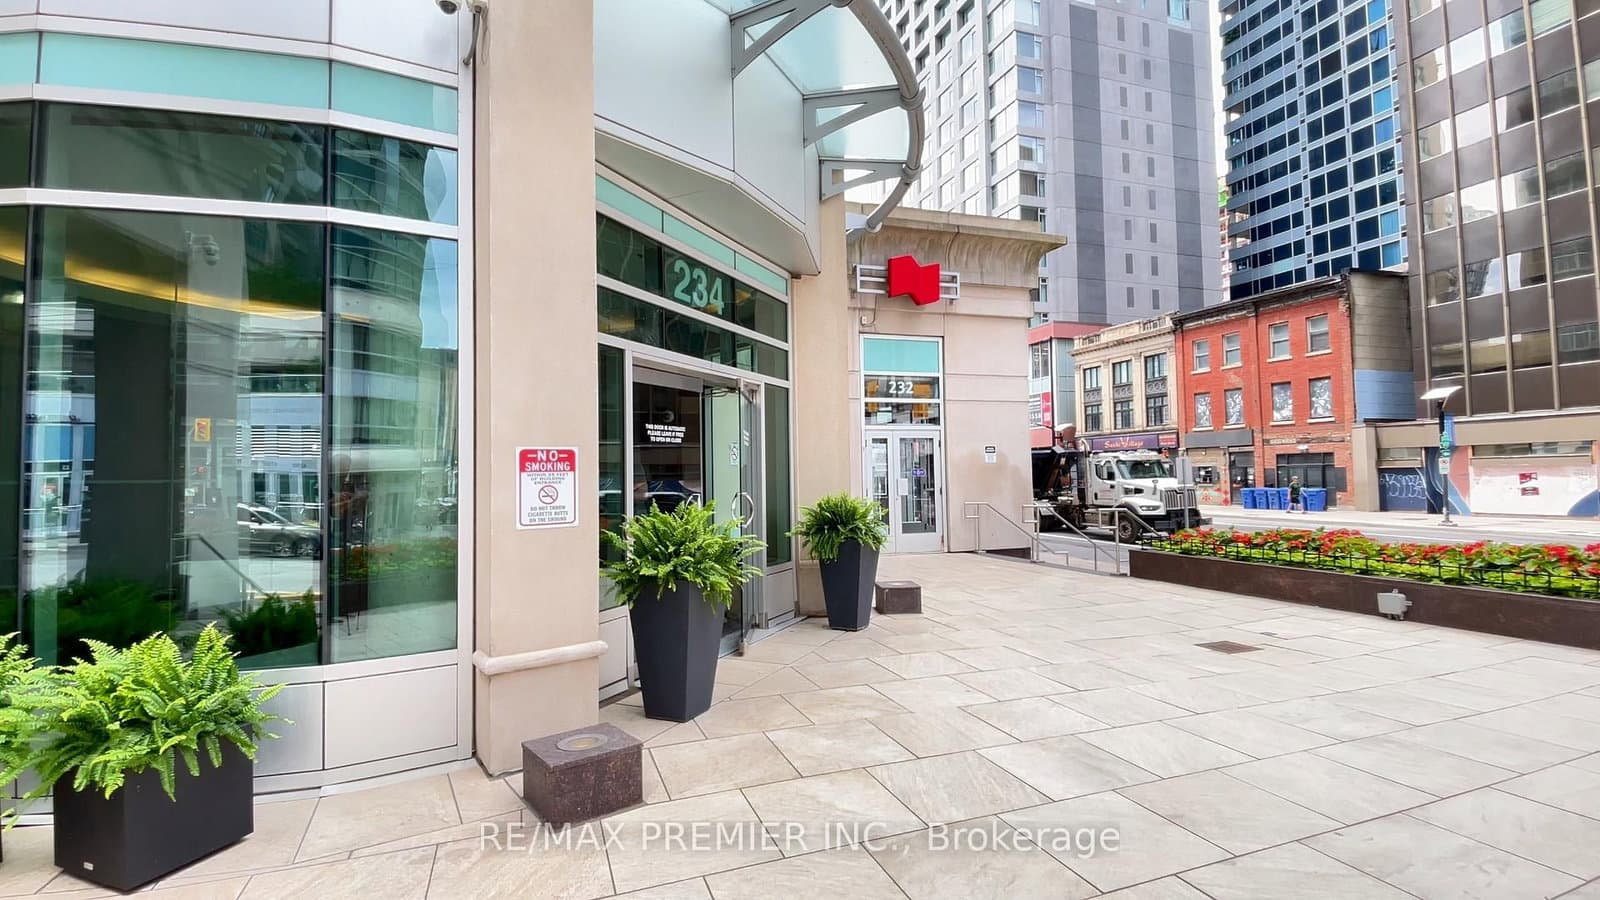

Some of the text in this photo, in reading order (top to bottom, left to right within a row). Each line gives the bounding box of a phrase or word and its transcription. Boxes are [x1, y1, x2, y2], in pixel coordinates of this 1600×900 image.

[674, 259, 725, 315] 234
[888, 381, 914, 394] 232
[537, 450, 558, 461] NO
[525, 461, 571, 471] SMOKING
